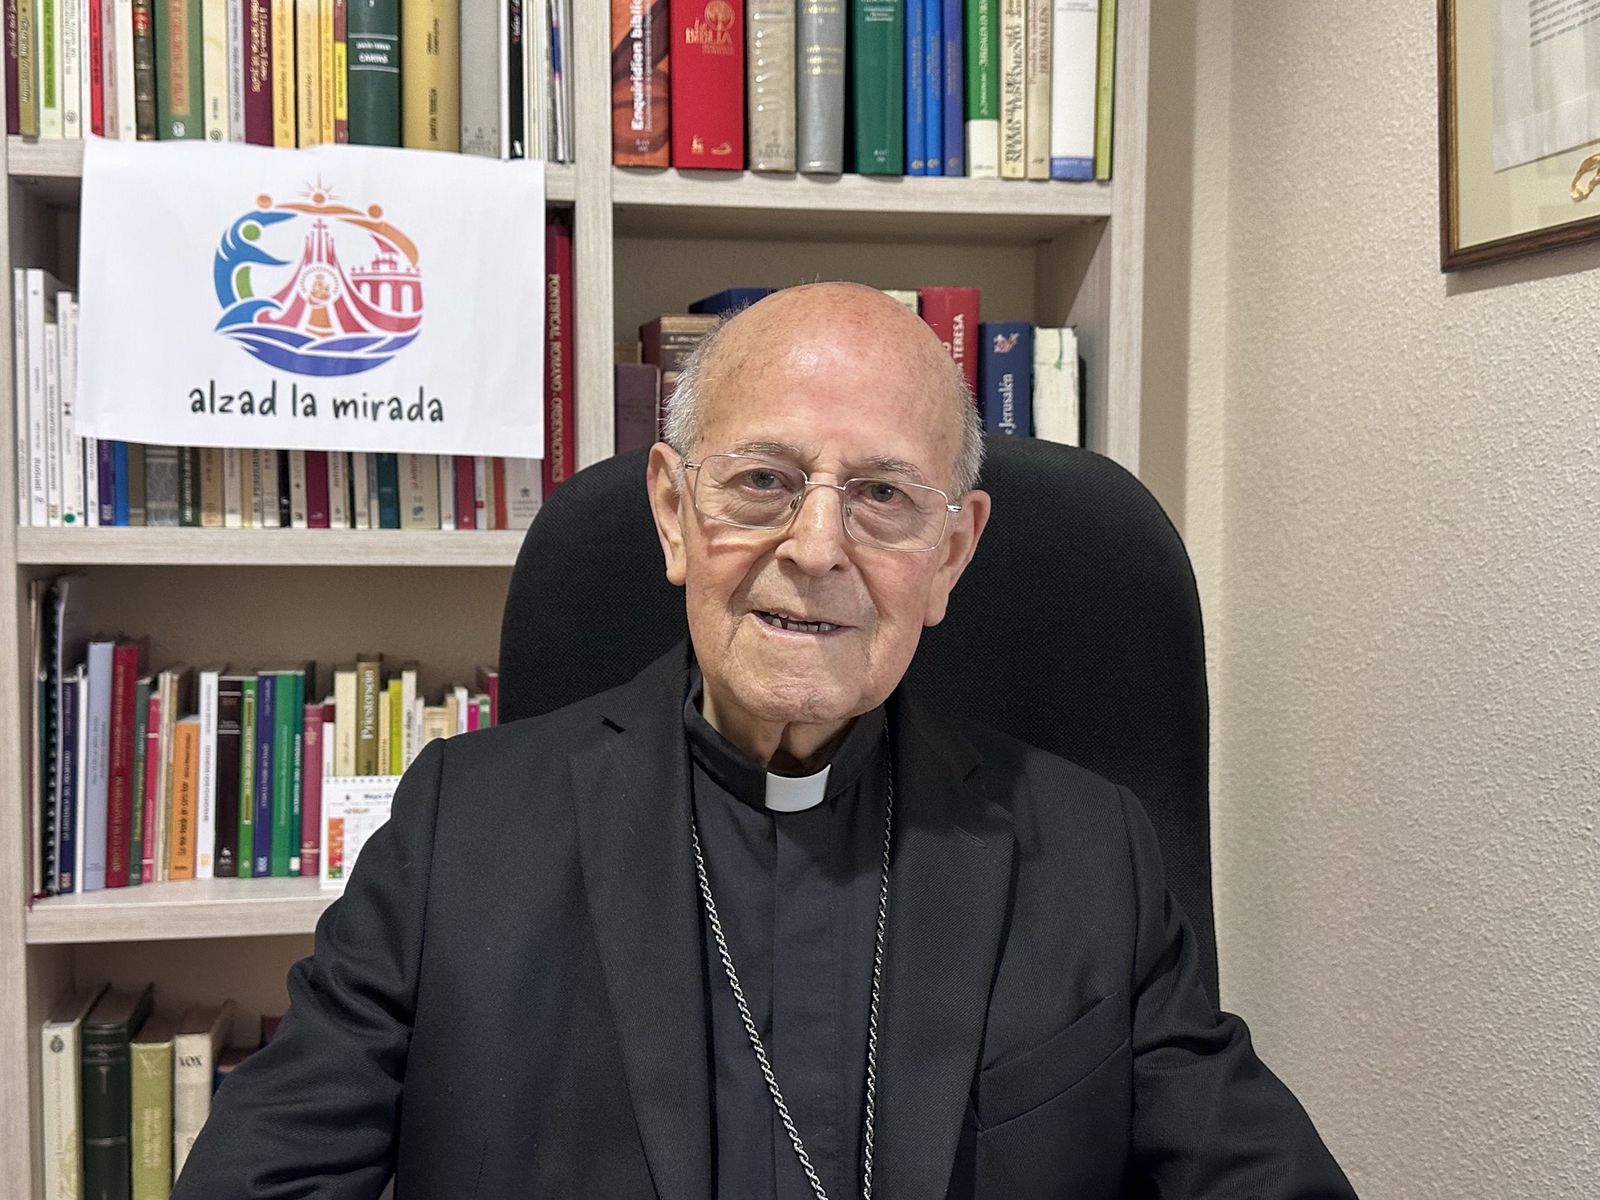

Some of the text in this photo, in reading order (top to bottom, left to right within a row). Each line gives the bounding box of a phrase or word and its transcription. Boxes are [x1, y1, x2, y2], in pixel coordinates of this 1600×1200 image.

[630, 42, 645, 131] Enquiridion
[952, 313, 965, 359] TERESA
[188, 380, 445, 423] alzad la mirada
[548, 273, 564, 483] PONTIFICAL ROMANO ORDENACIONES
[998, 373, 1016, 428] Jerusalén
[360, 669, 375, 740] Priestersein
[179, 1055, 204, 1068] VOX
